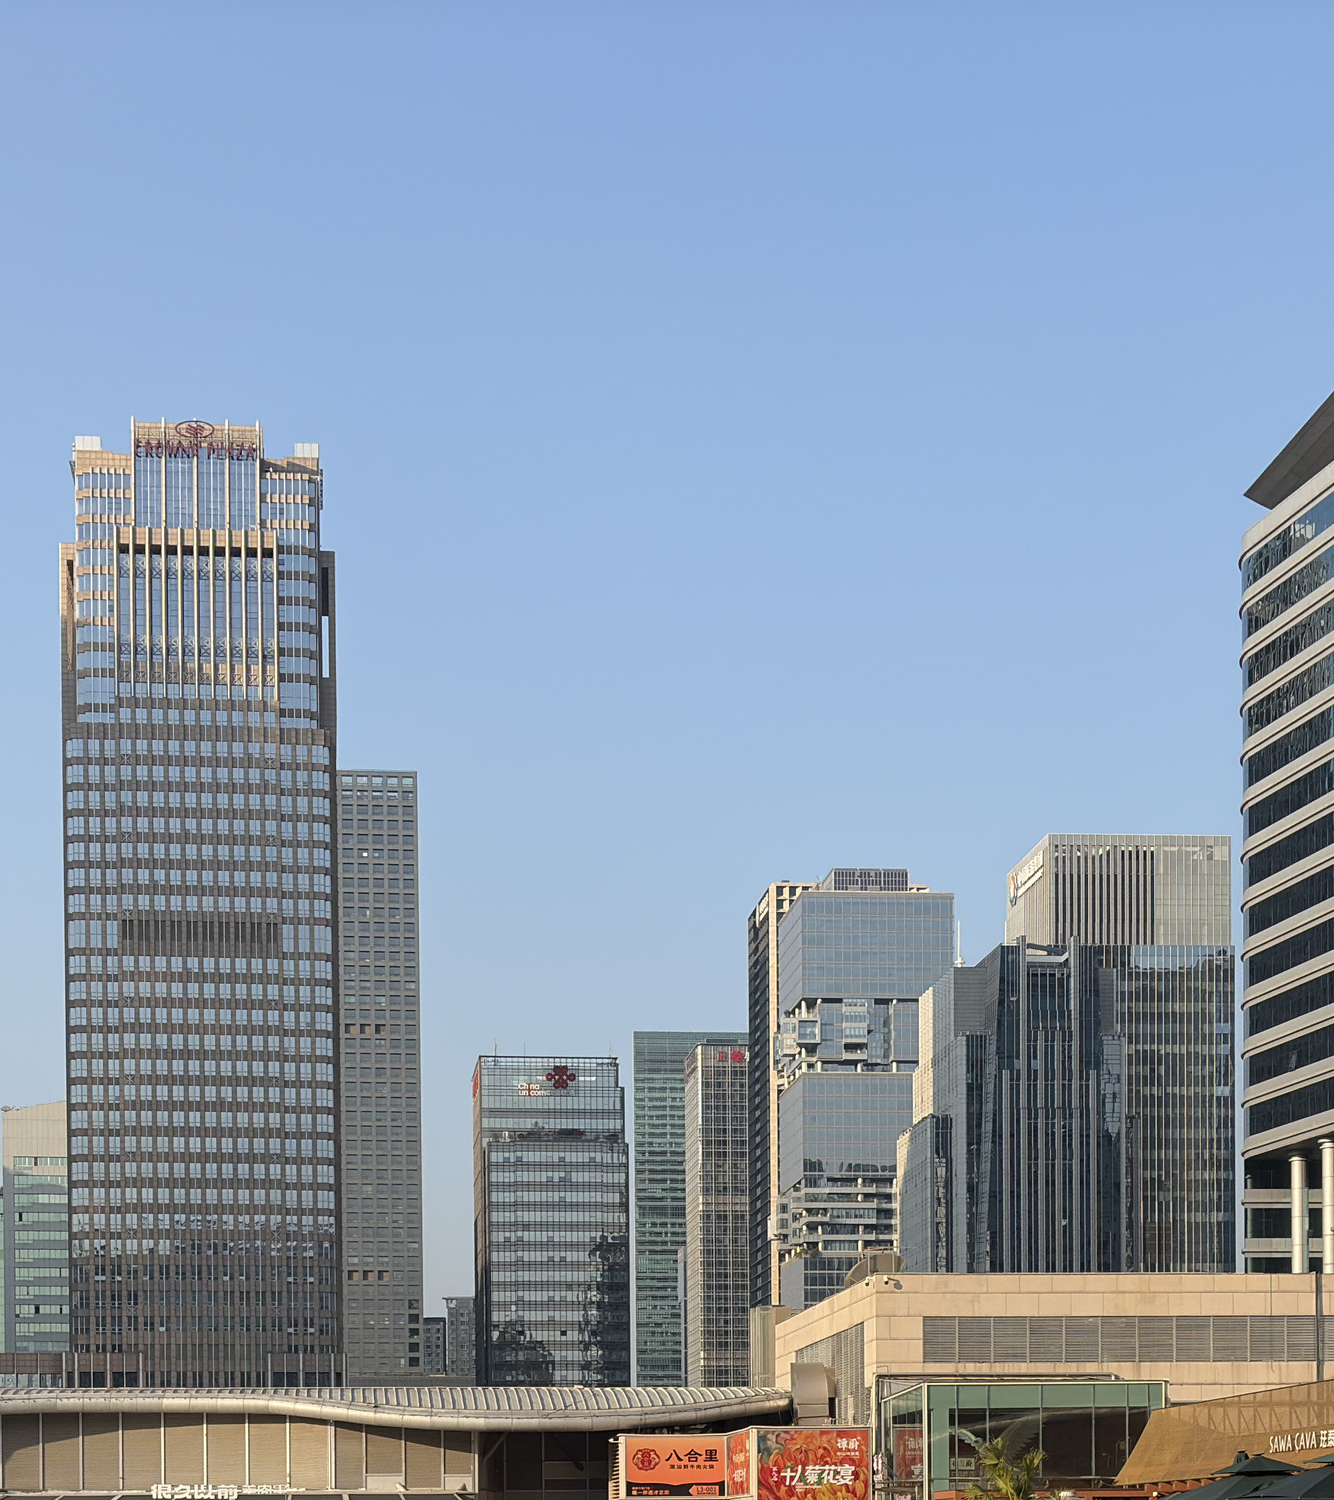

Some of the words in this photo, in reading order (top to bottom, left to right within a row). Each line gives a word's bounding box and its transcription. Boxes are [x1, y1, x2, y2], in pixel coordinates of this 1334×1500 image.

[134, 438, 199, 459] CROWNE
[207, 441, 256, 461] PLAZA
[1269, 1433, 1293, 1454] SAWA
[1294, 1430, 1317, 1454] ÇAVA
[665, 1448, 720, 1463] 八合里
[780, 1464, 856, 1486] 千人菊花宴
[150, 1483, 238, 1500] 很久以前
